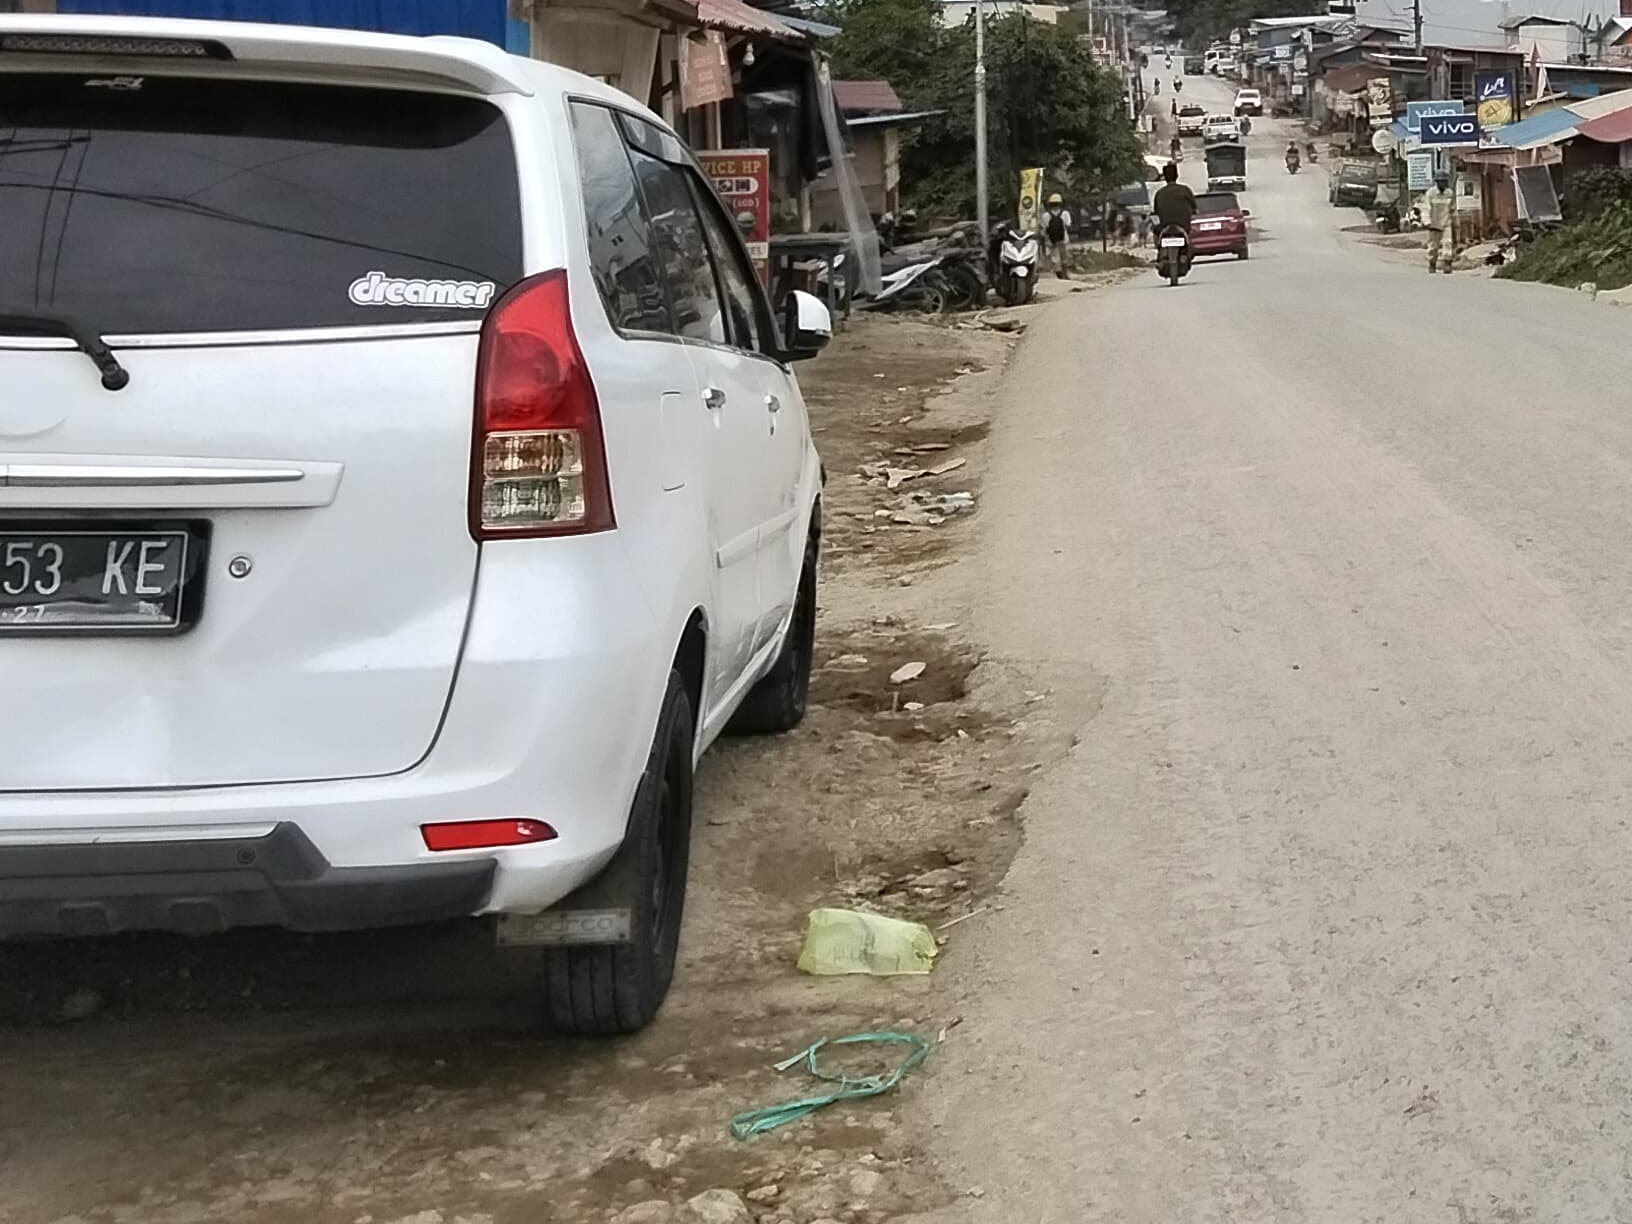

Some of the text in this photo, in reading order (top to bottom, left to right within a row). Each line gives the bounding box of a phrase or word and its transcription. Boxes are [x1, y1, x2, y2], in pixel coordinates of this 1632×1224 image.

[1429, 121, 1474, 134] vivo
[742, 160, 762, 173] HP
[349, 271, 496, 309] dreamer
[102, 541, 168, 594] KE
